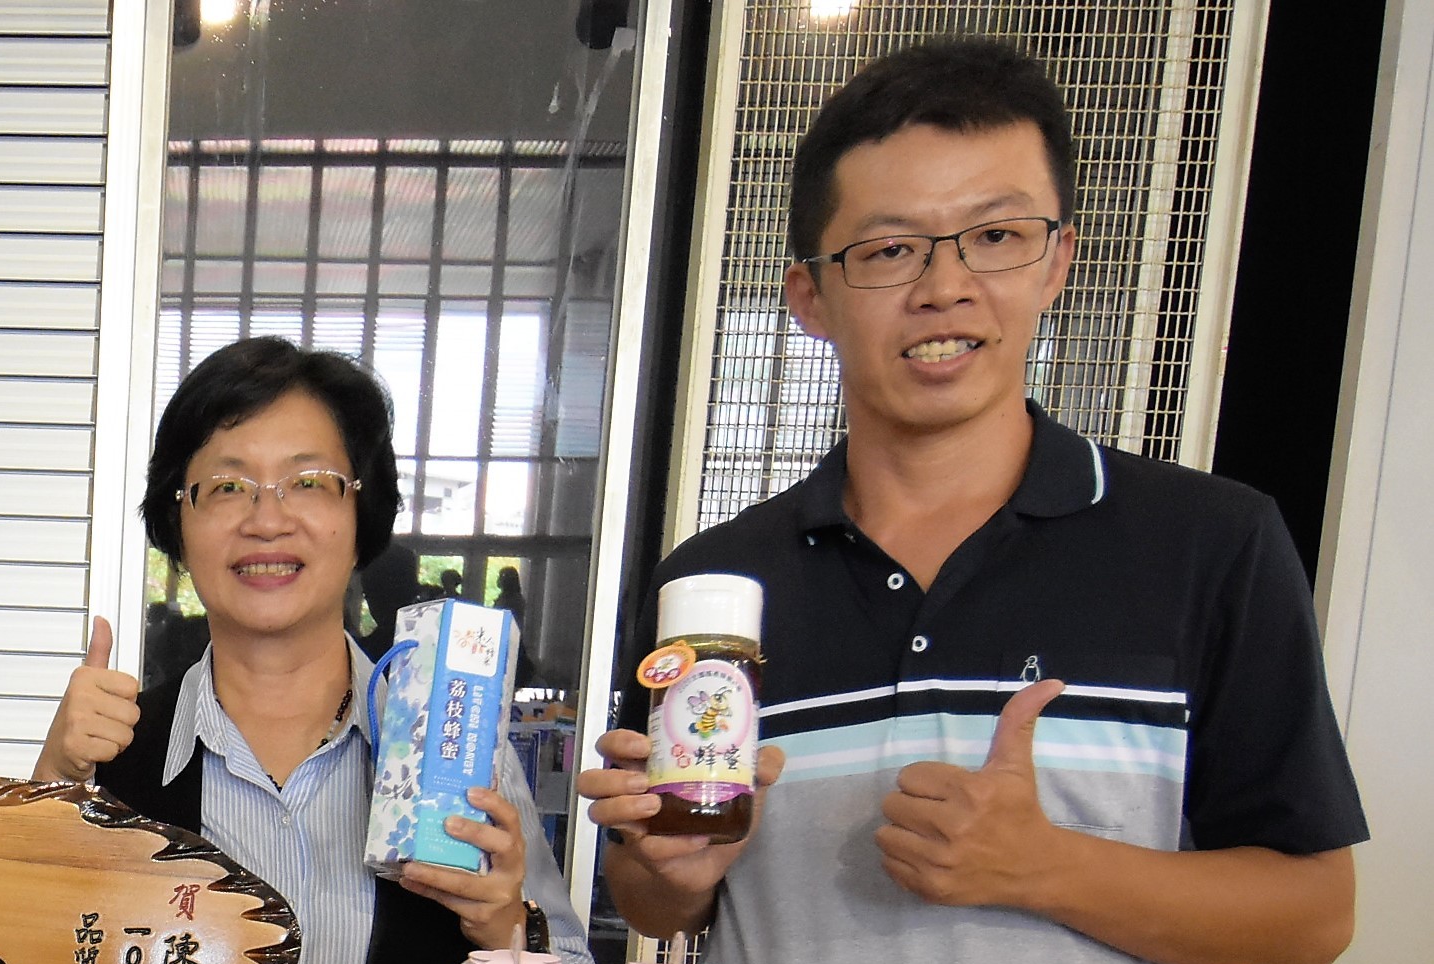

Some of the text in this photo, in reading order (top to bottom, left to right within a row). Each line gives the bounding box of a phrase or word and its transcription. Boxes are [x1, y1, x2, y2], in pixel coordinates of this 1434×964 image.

[440, 678, 468, 761] 荔枝蜂蜜
[462, 685, 484, 776] LITCHI HONEY
[694, 743, 742, 772] 蜂蜜
